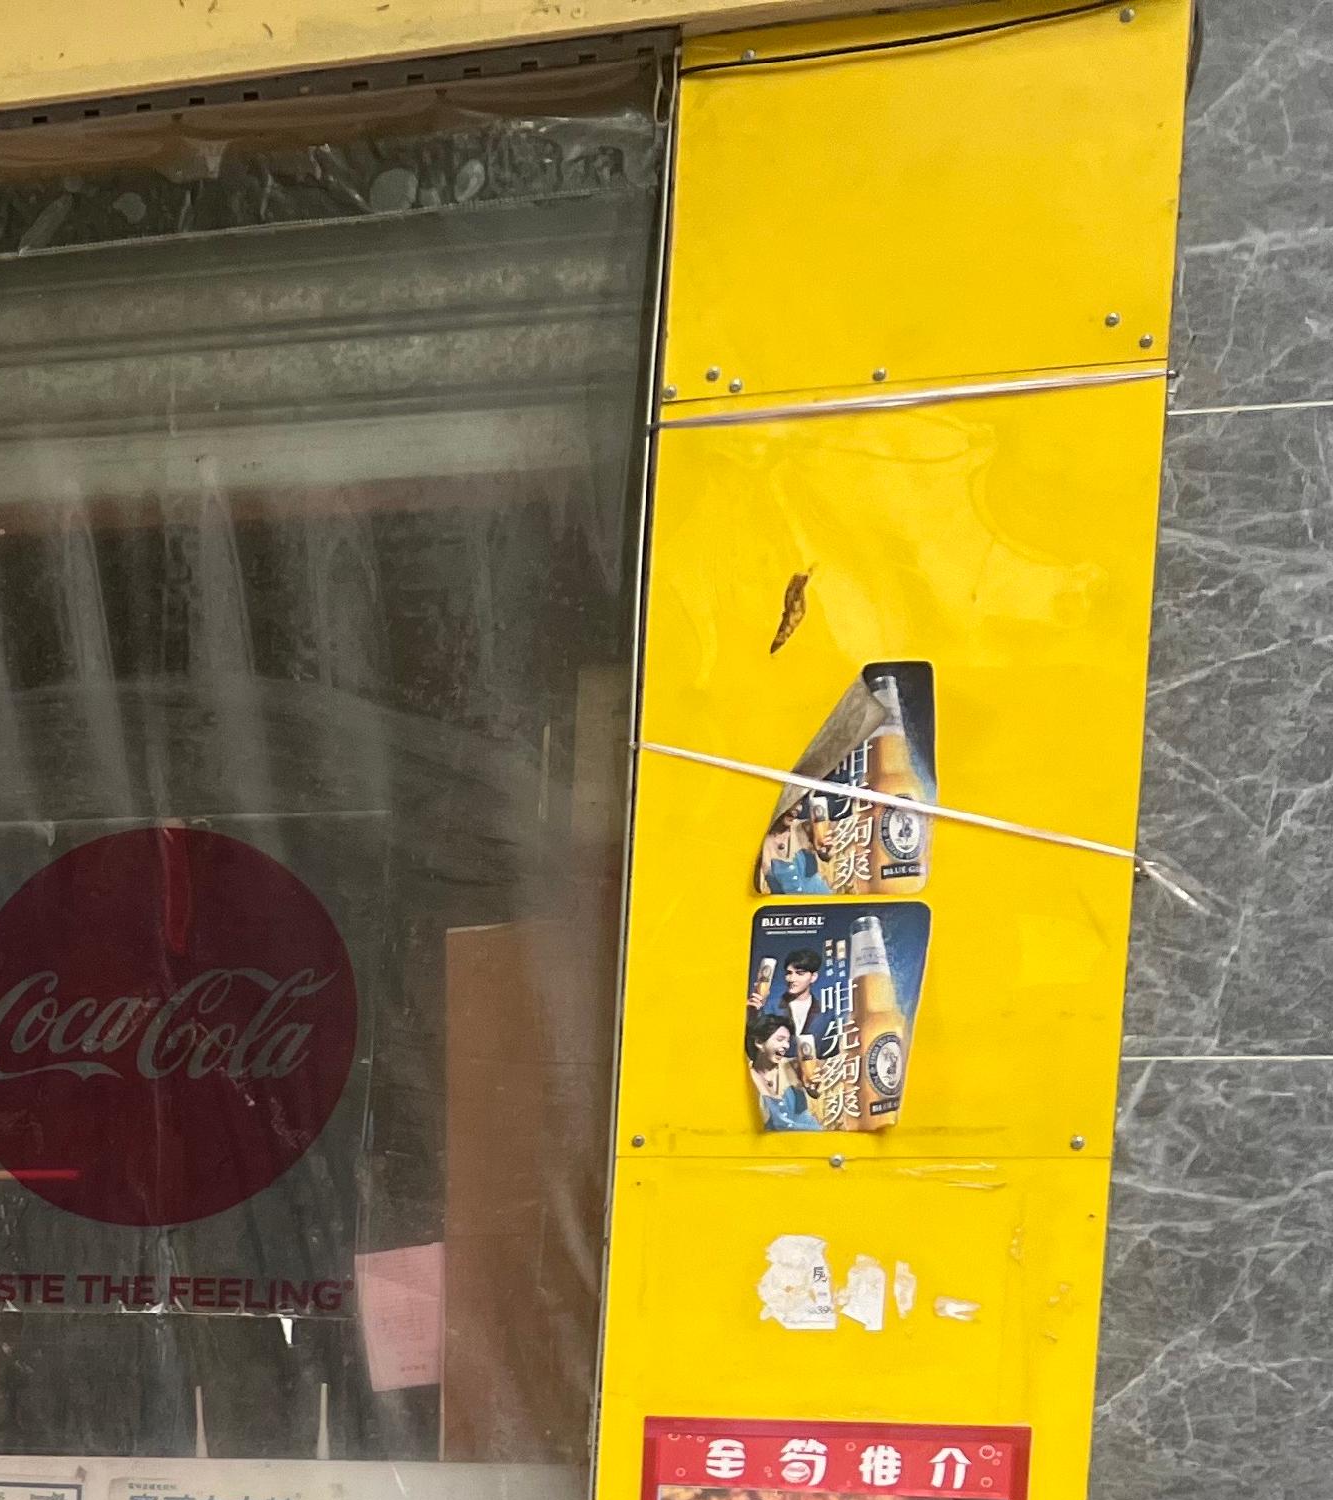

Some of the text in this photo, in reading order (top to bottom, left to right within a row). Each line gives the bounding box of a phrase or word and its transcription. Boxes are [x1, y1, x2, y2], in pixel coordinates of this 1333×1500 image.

[834, 740, 873, 888] 咁先夠爽
[761, 914, 824, 927] BLUE GIRL
[819, 979, 861, 1124] 咁先夠爽
[77, 1273, 157, 1306] THE
[168, 1276, 345, 1312] FEELING
[705, 1438, 972, 1490] 至筍推介
